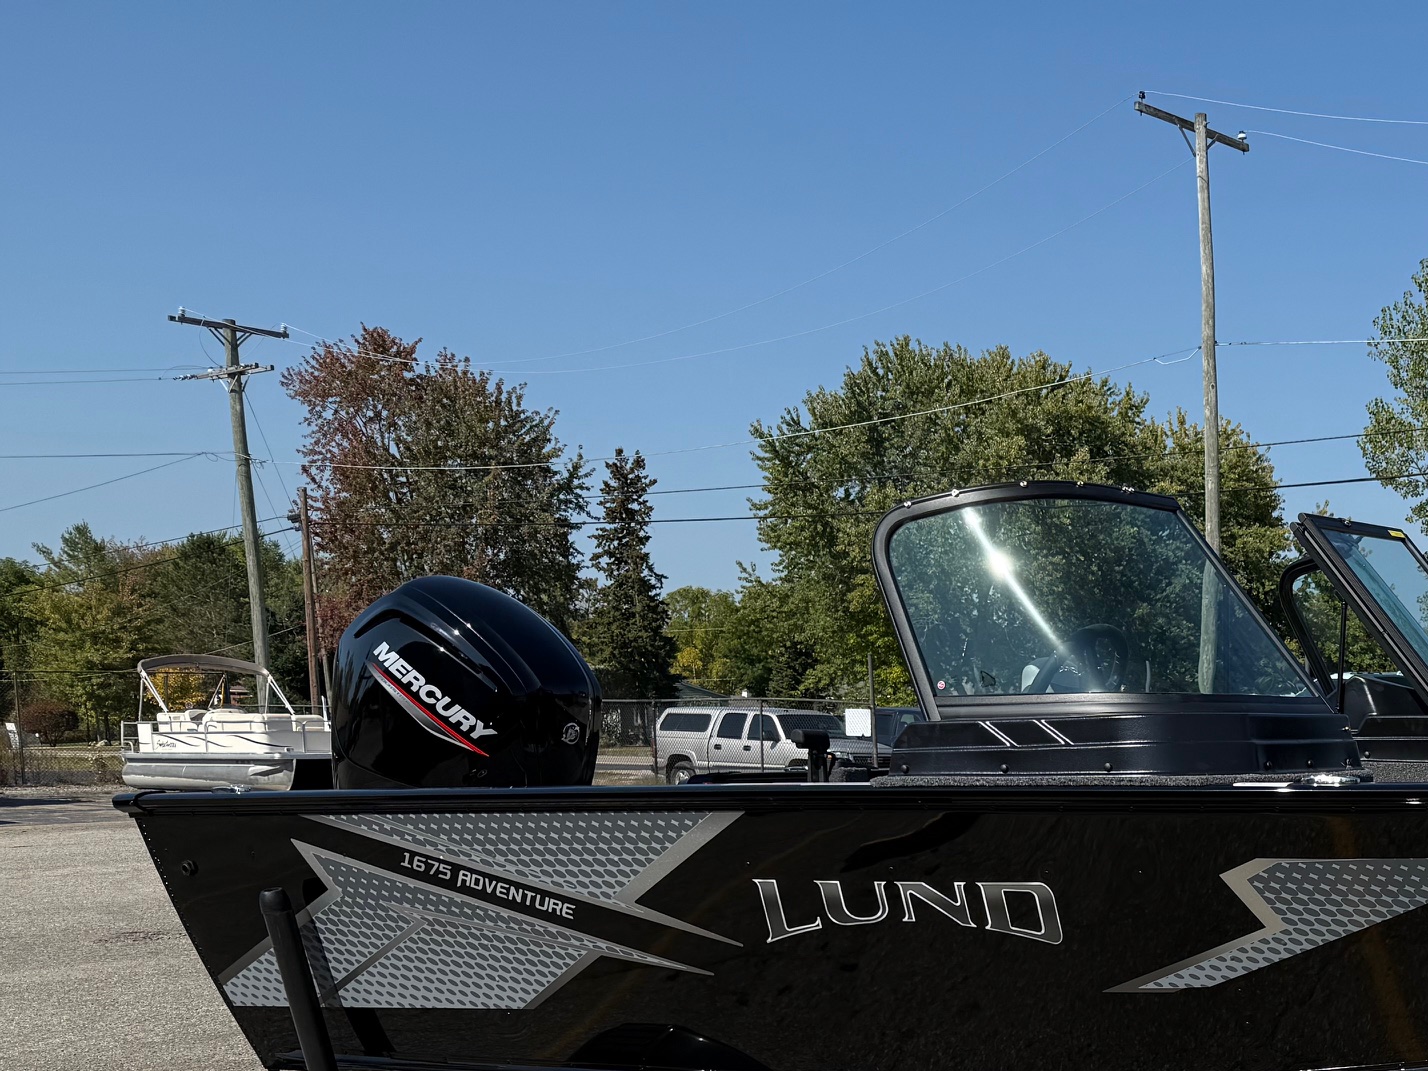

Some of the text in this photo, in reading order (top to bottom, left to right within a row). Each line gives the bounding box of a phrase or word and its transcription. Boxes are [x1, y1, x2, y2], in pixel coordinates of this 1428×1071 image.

[373, 641, 498, 740] MERCURY
[400, 852, 576, 920] 1675 ADVENTURE
[752, 879, 1063, 945] LUND
